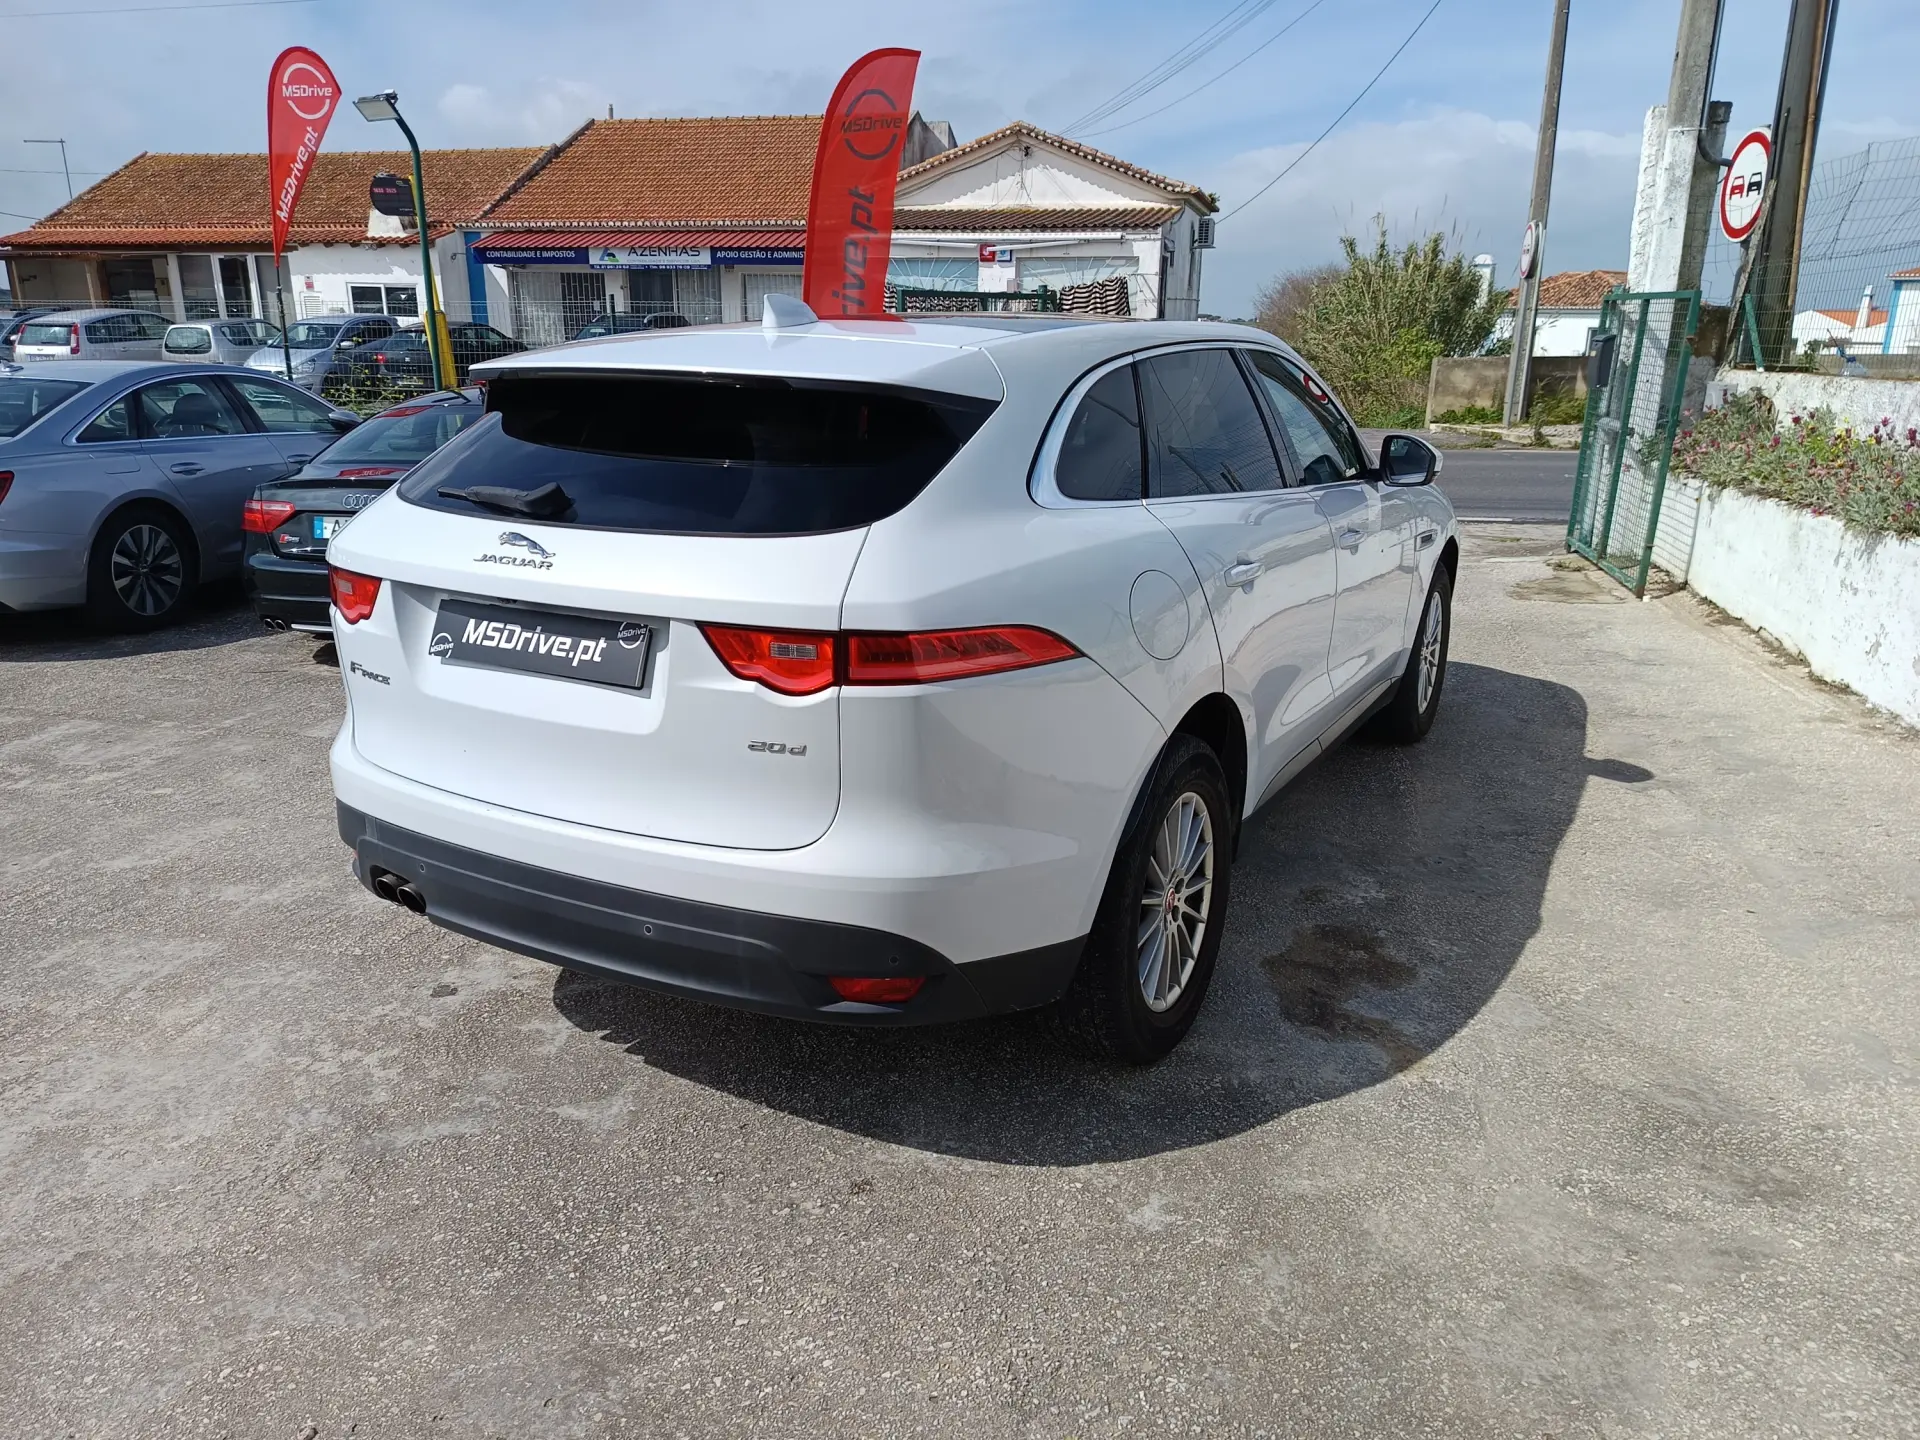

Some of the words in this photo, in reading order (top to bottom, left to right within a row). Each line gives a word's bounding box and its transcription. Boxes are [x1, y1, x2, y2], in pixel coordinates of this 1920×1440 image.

[282, 84, 332, 97] MSDrive
[841, 116, 903, 133] MSDrive
[276, 126, 319, 223] MSDrive.pt
[486, 250, 535, 258] CONTABILIDADE
[542, 250, 576, 258] IMPOSTOS
[627, 245, 701, 257] AZENHAS
[740, 249, 766, 258] GESTÃO
[473, 553, 553, 570] JAGUAR
[617, 626, 647, 639] MSDrive
[430, 641, 454, 653] MSDrive
[461, 618, 607, 667] MSDrive.pt
